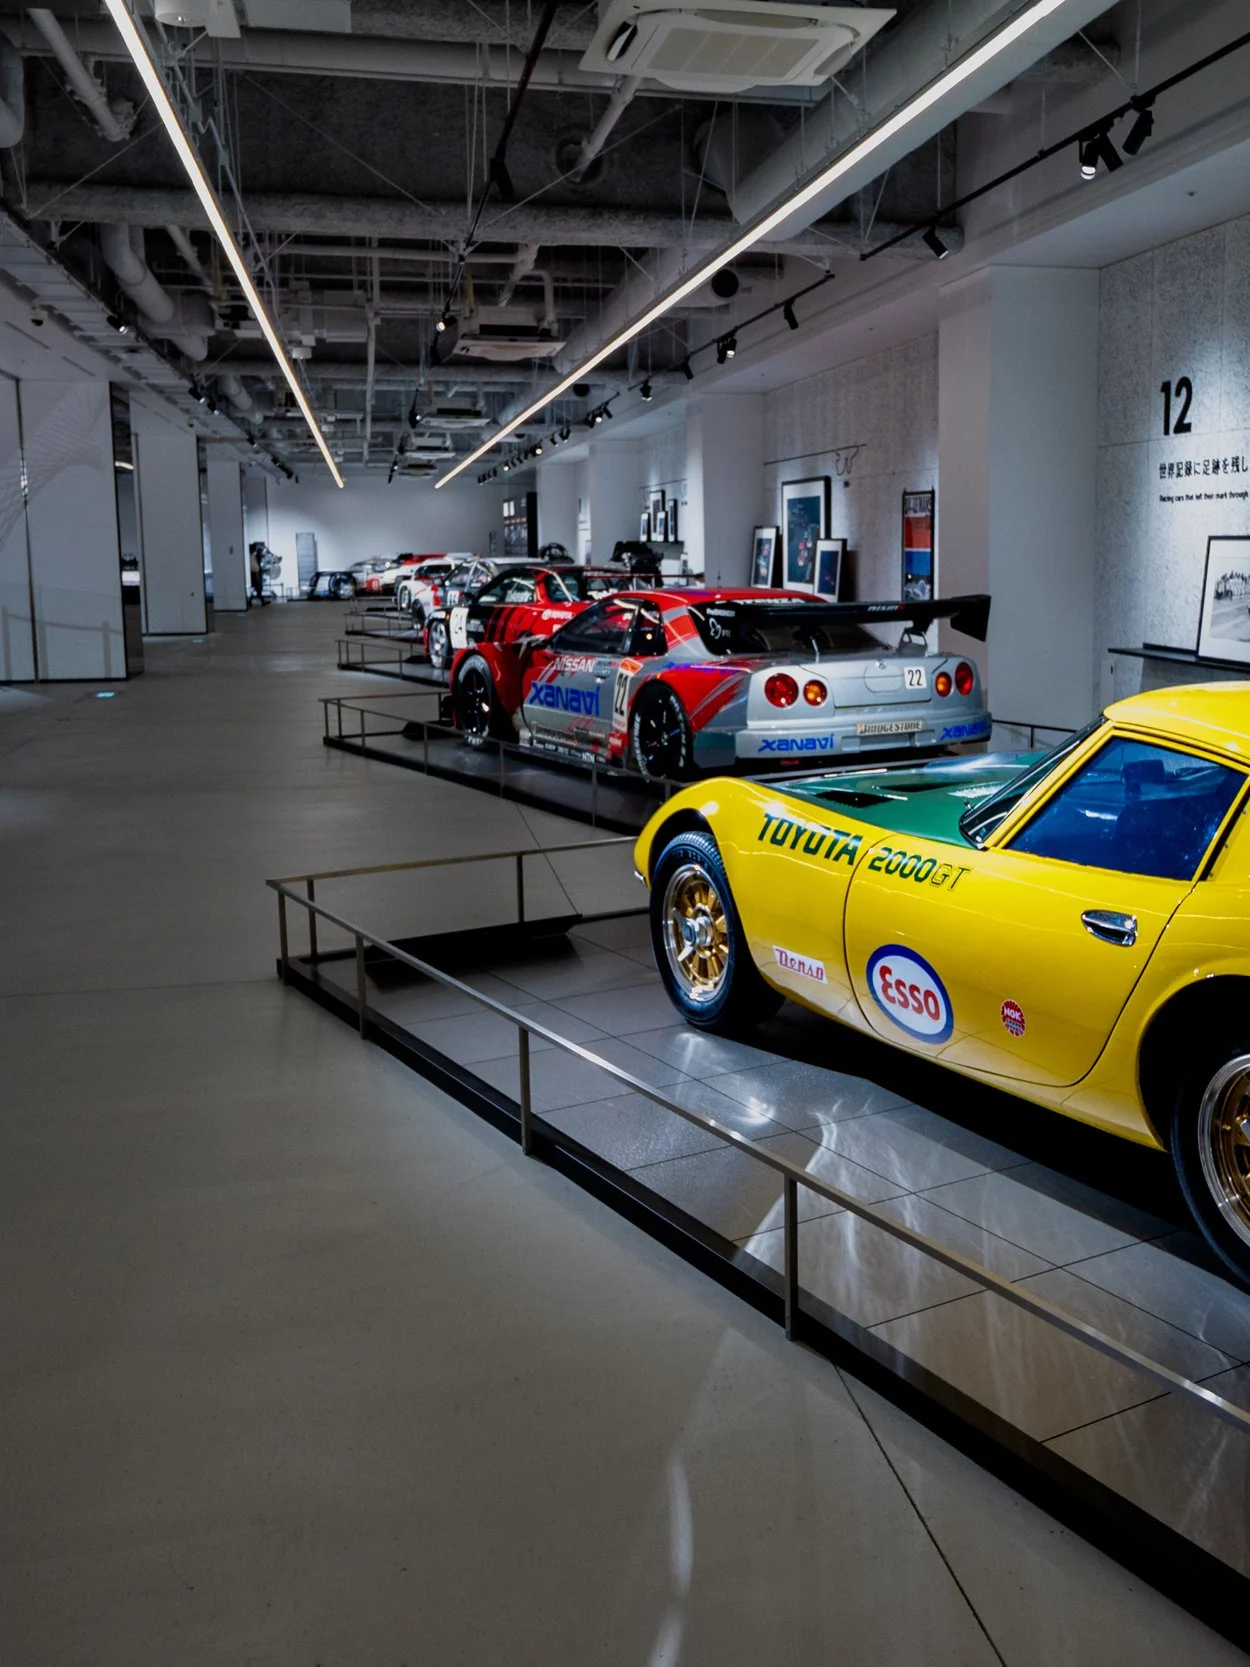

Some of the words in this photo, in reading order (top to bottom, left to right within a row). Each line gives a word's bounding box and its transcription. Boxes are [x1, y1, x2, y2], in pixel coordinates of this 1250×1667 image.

[1160, 376, 1193, 436] 12
[1159, 494, 1174, 503] Racing
[1229, 490, 1249, 500] through
[552, 656, 596, 673] NISSAN
[907, 669, 923, 687] 22
[614, 672, 630, 716] 22
[859, 720, 921, 735] BRIDGESTONE
[757, 813, 864, 866] TOYOTA
[868, 847, 971, 892] 2000GT
[1004, 1005, 1021, 1022] NGK
